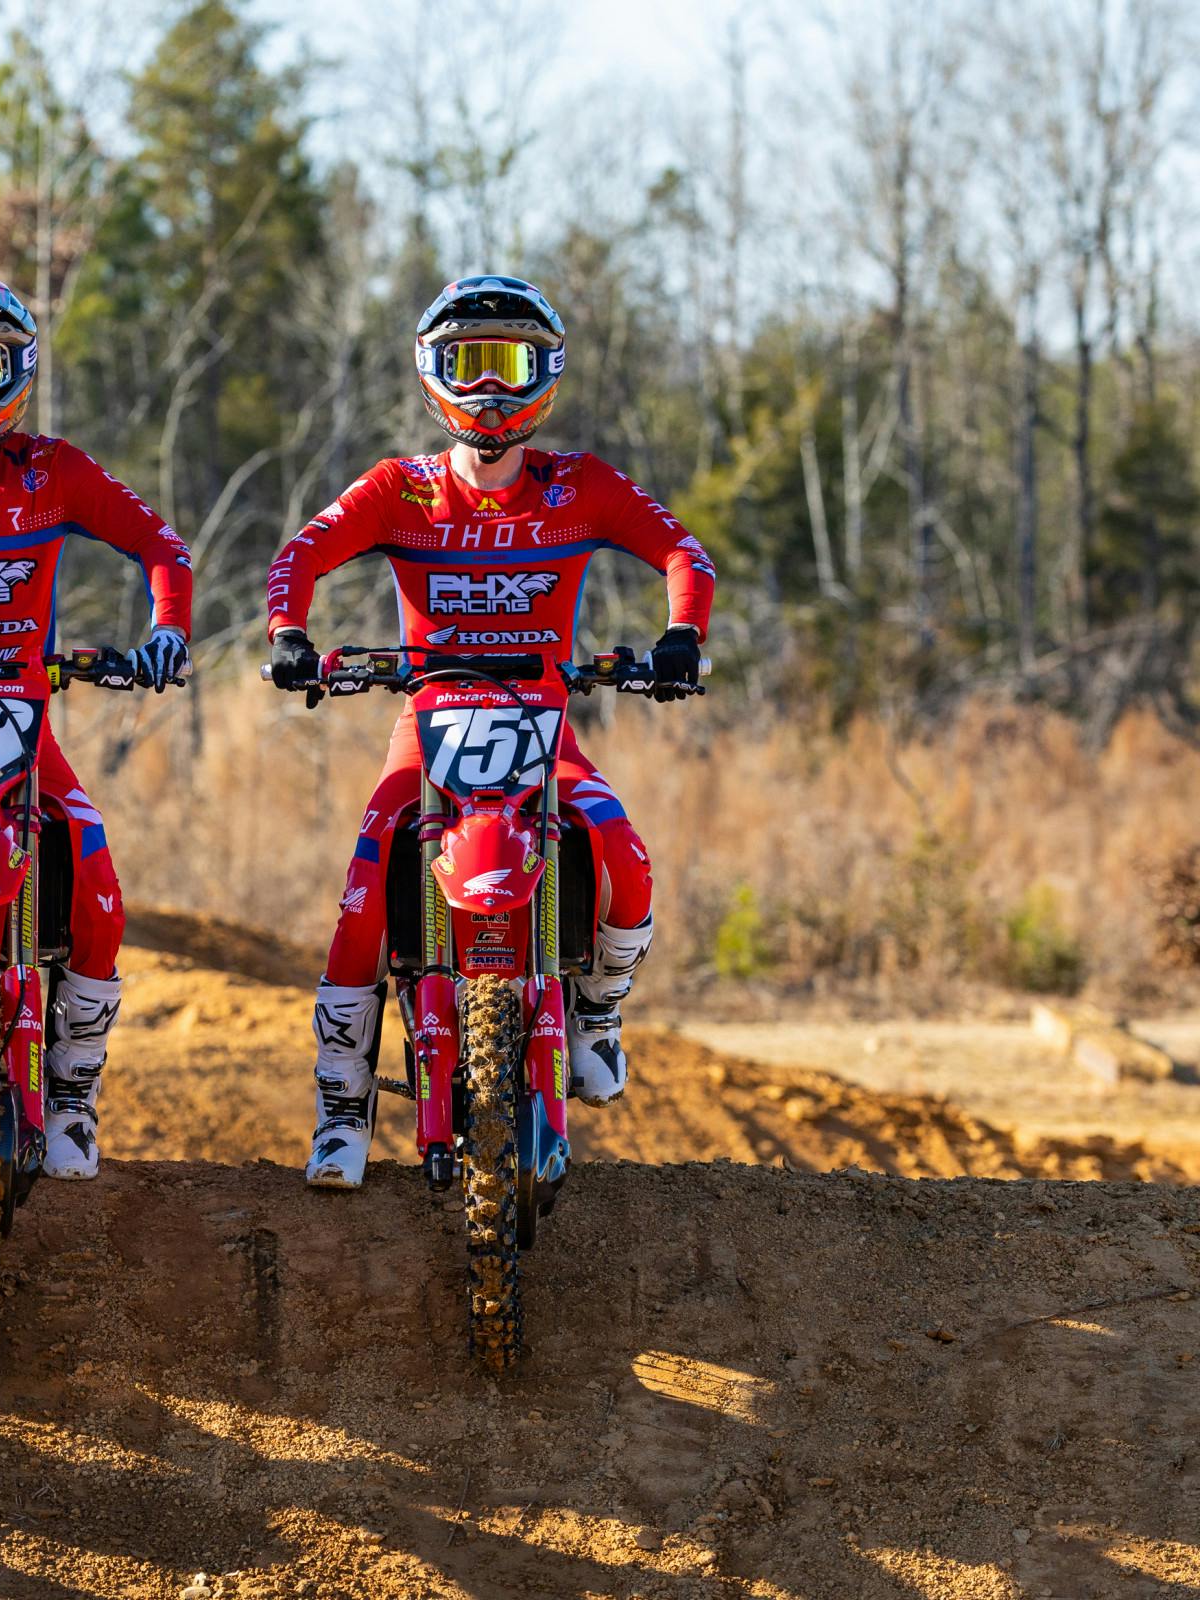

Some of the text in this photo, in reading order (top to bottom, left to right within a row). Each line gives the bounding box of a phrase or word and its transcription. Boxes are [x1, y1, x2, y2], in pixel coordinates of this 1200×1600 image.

[434, 521, 545, 548] THOR
[428, 573, 529, 599] PHX
[457, 630, 561, 645] HONDA
[100, 675, 133, 686] ASV
[331, 681, 364, 692] ASV
[621, 680, 655, 690] ASV
[436, 691, 543, 705] phx-racing.om
[428, 707, 561, 789] 751
[463, 888, 514, 898] HONDA
[436, 884, 447, 948] actory
[545, 858, 556, 959] Connection
[466, 956, 514, 964] PARTS
[29, 1041, 39, 1092] TAMER
[553, 1049, 564, 1100] TAMER
